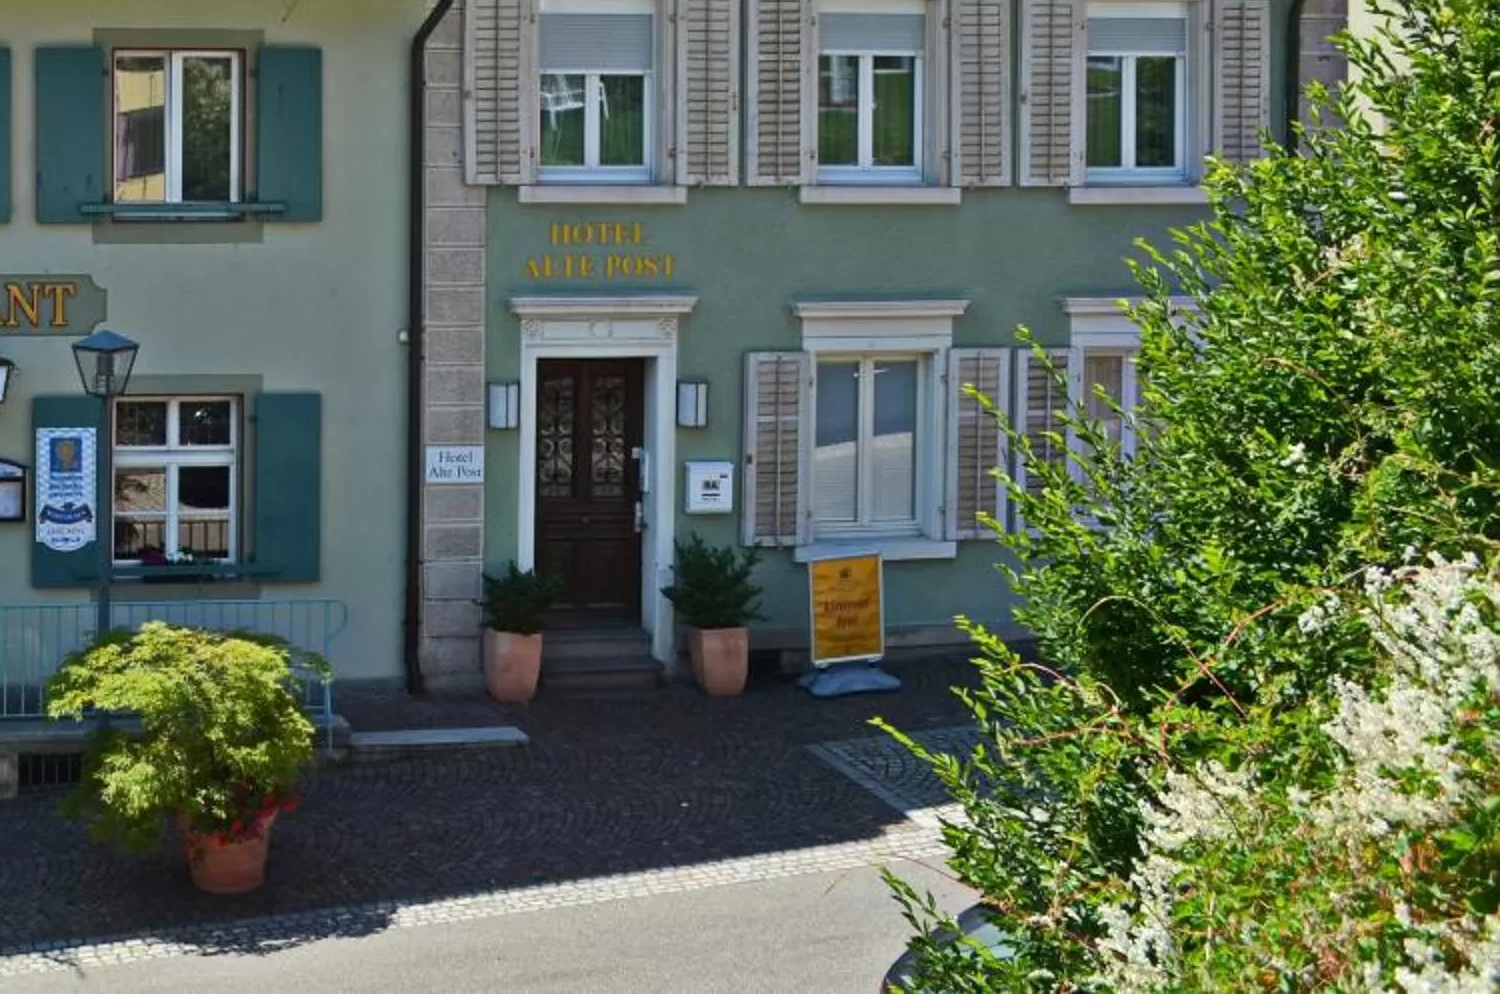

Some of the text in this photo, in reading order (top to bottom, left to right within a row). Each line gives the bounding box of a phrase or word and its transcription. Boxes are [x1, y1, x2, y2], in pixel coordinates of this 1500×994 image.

[550, 221, 649, 246] HOTEL
[521, 254, 676, 279] ALTE POST
[438, 451, 473, 463] Hotel
[428, 465, 482, 479] Alte Post
